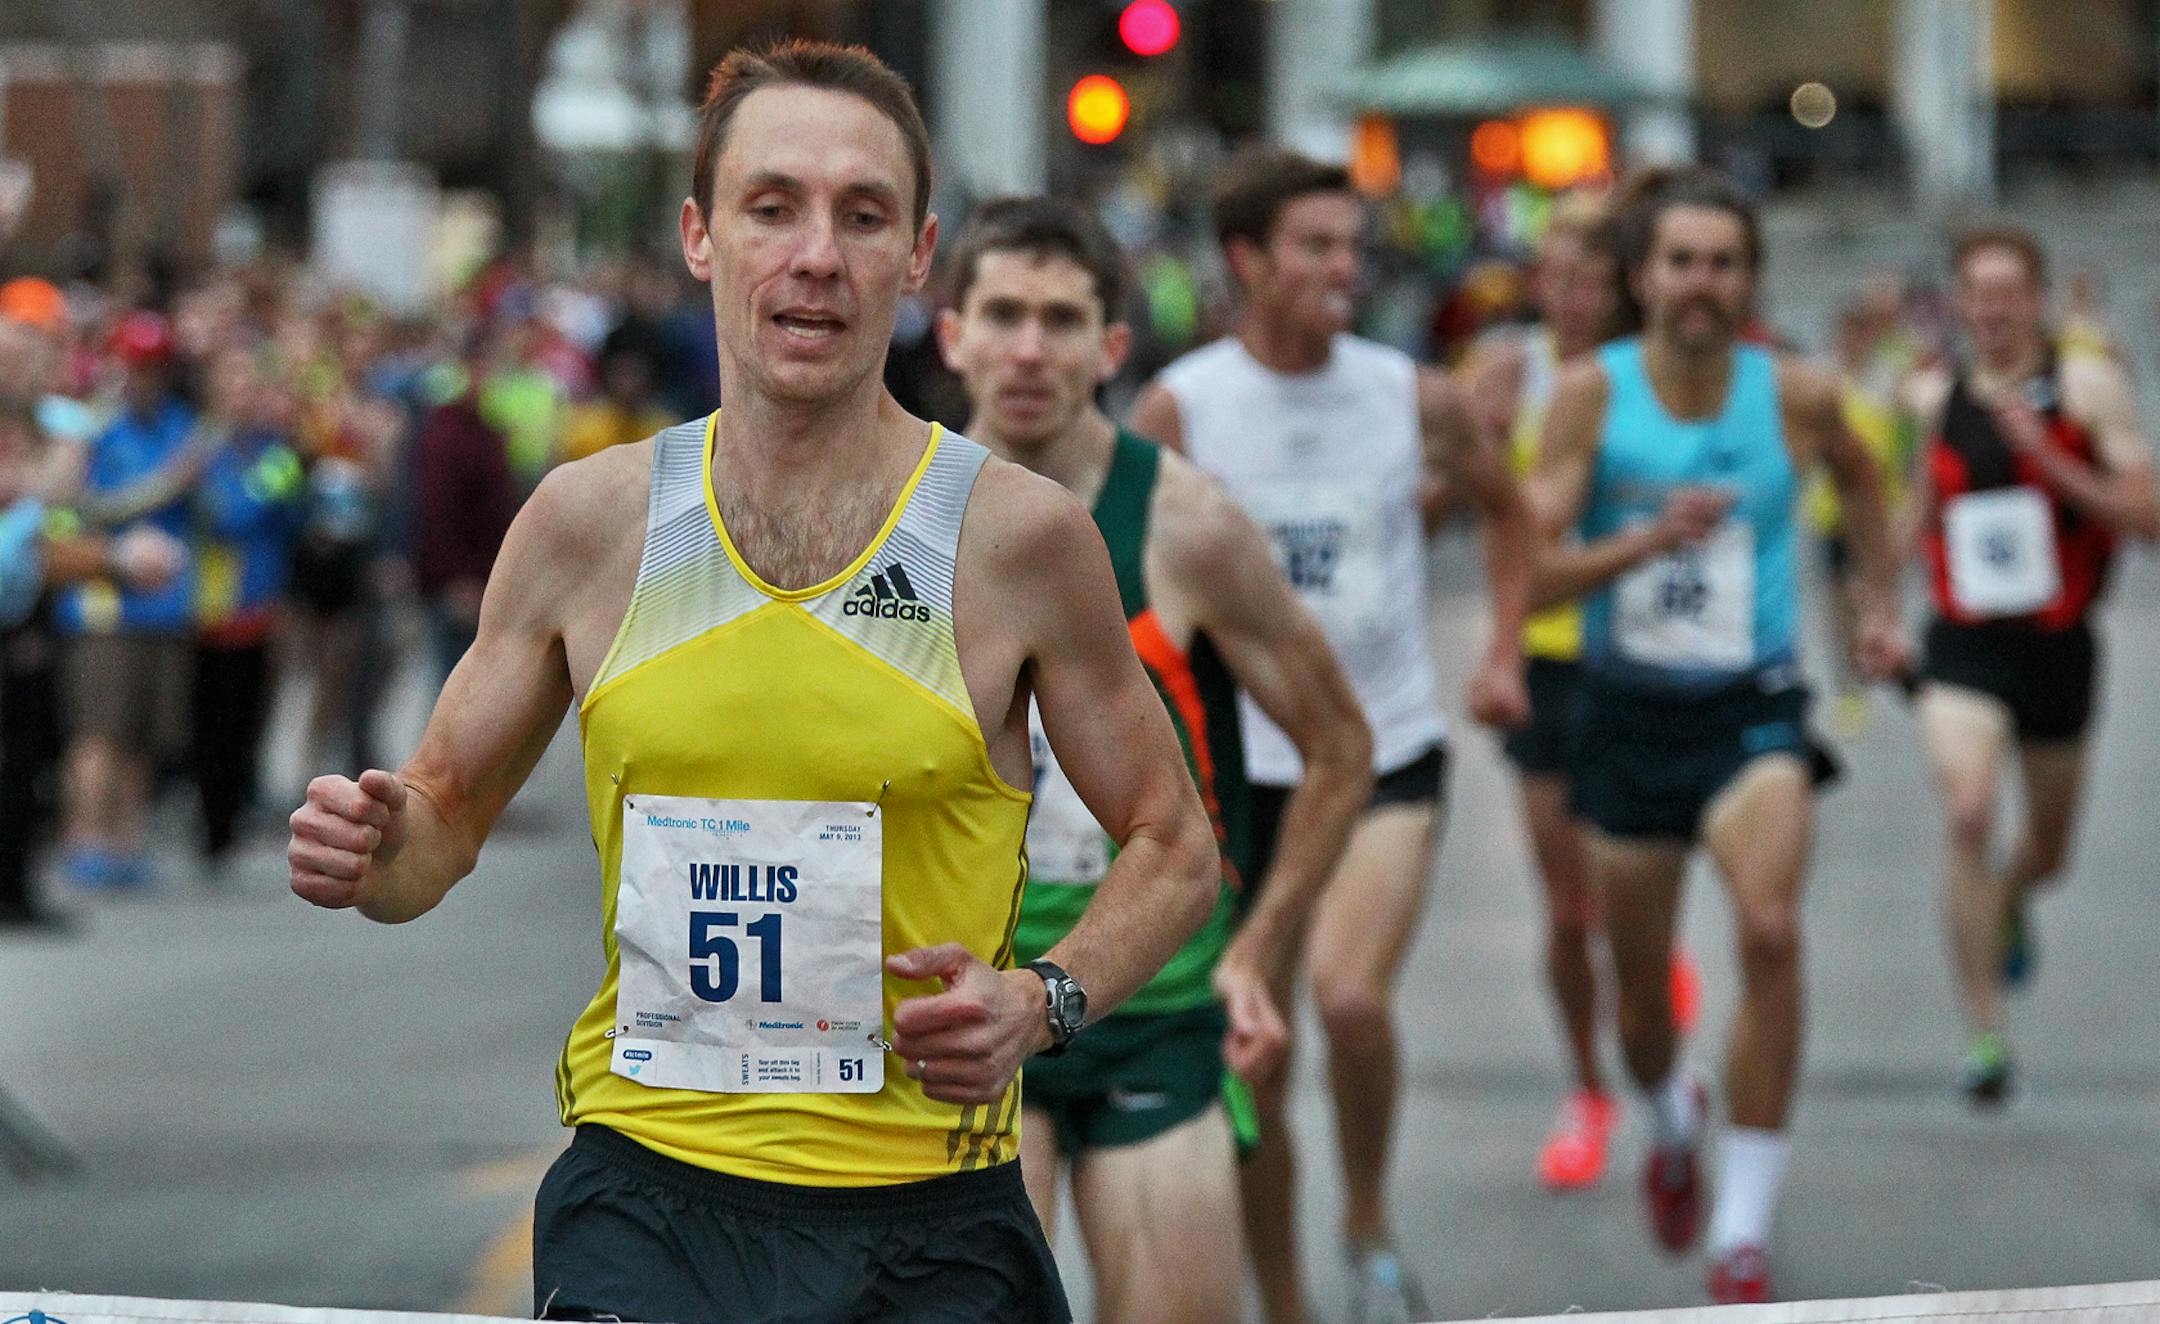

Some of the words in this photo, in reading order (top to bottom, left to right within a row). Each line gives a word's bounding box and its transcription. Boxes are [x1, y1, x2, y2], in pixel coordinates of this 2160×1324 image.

[843, 596, 930, 622] adidas
[647, 815, 697, 829] Medtronic
[700, 818, 716, 830] TC
[718, 819, 723, 831] 1
[726, 819, 750, 831] Mile
[689, 863, 798, 902] WILLIS
[689, 911, 782, 1003] 51
[636, 1011, 682, 1022] PROFESSIONAL
[636, 1020, 663, 1028] DIVISION
[758, 1021, 804, 1029] Medtronic
[839, 1058, 864, 1081] 51
